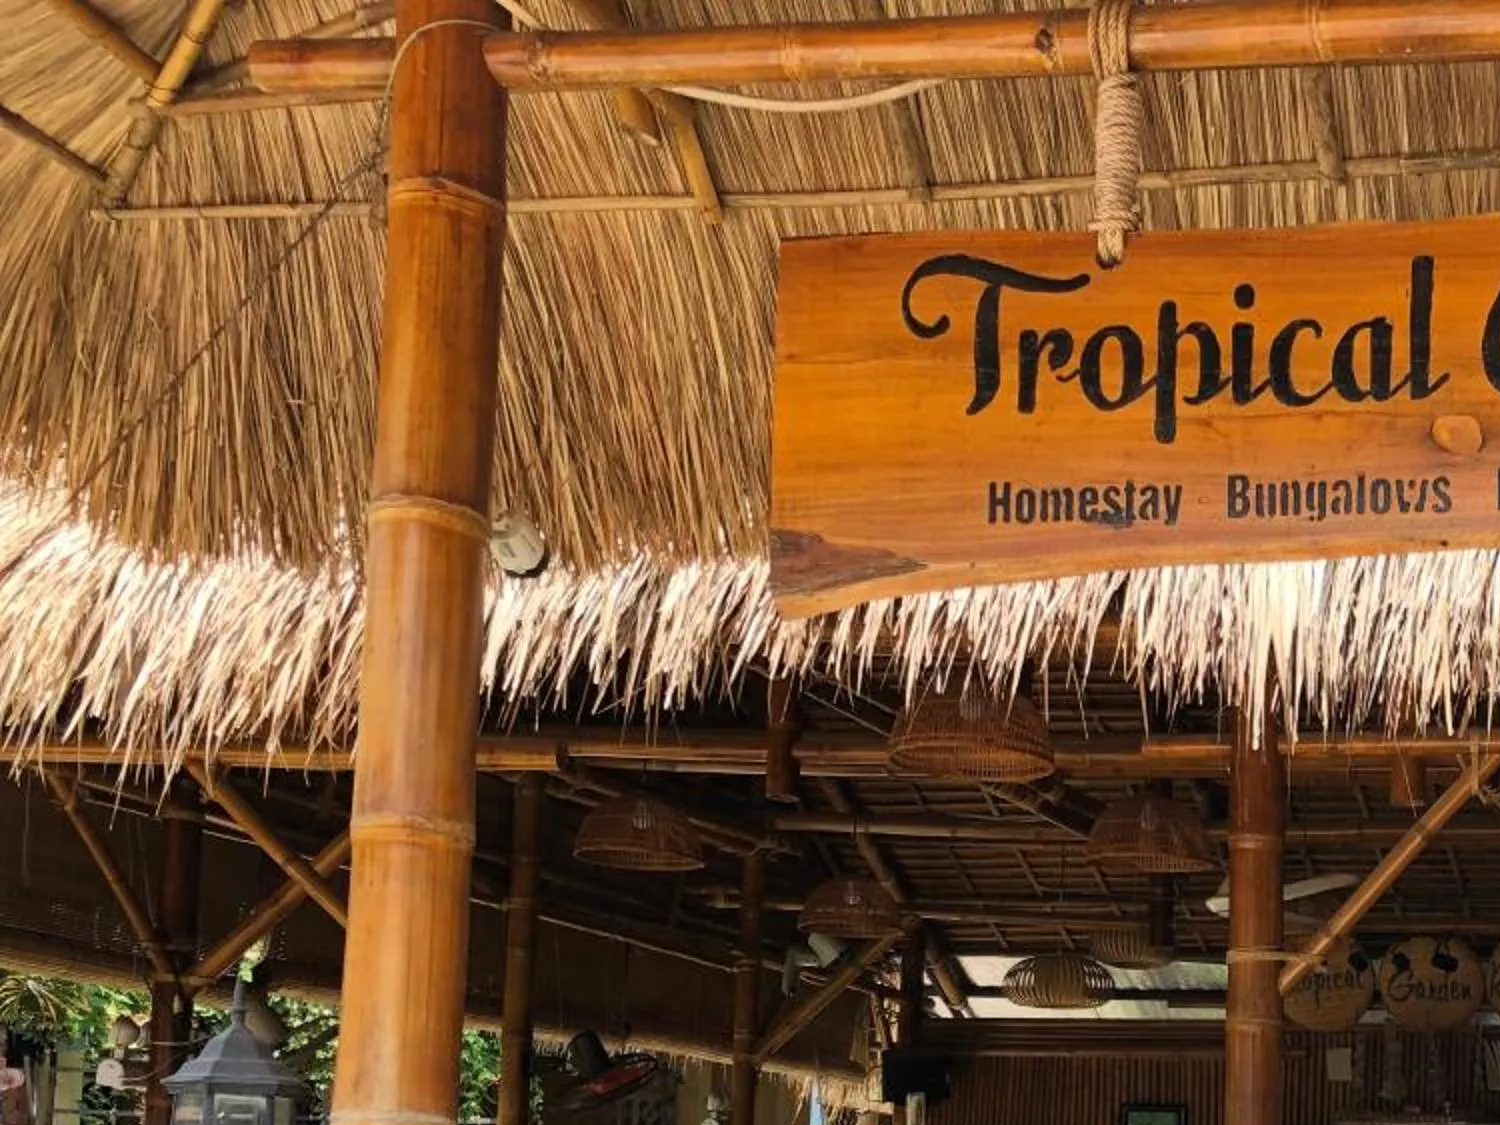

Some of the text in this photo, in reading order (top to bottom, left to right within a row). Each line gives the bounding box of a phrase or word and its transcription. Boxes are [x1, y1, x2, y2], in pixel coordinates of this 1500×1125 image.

[902, 253, 1451, 444] Tropical
[988, 480, 1183, 526] Homestay
[1227, 474, 1452, 522] Bungalows
[1387, 969, 1472, 1002] Garden
